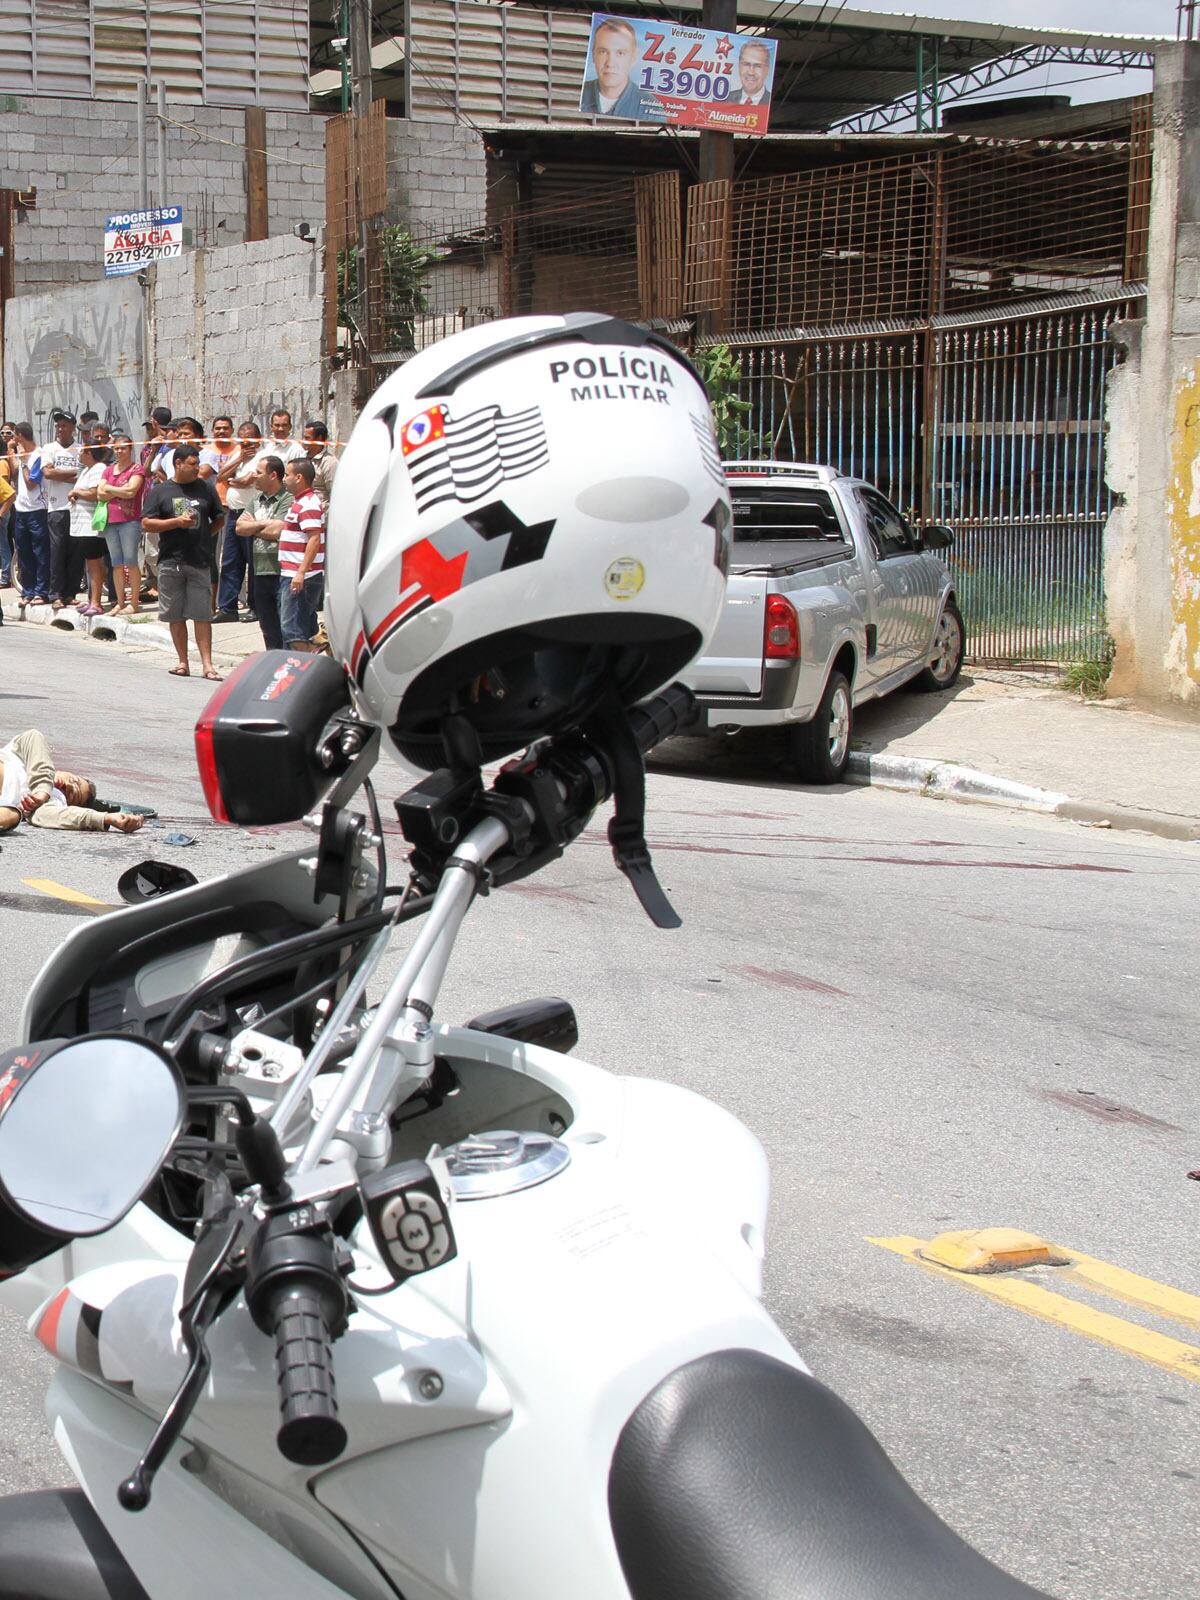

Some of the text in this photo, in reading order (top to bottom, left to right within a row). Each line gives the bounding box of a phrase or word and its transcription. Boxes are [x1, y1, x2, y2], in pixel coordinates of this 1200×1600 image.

[671, 27, 706, 41] Vereador
[642, 31, 733, 76] Zé Luiz
[640, 67, 730, 101] 13900
[708, 110, 746, 124] Almeida
[746, 113, 758, 128] 13
[109, 208, 178, 227] PROGRESSO
[113, 230, 173, 249] ALUGA
[549, 351, 674, 388] POLÍCIA
[570, 384, 670, 405] MILITAR
